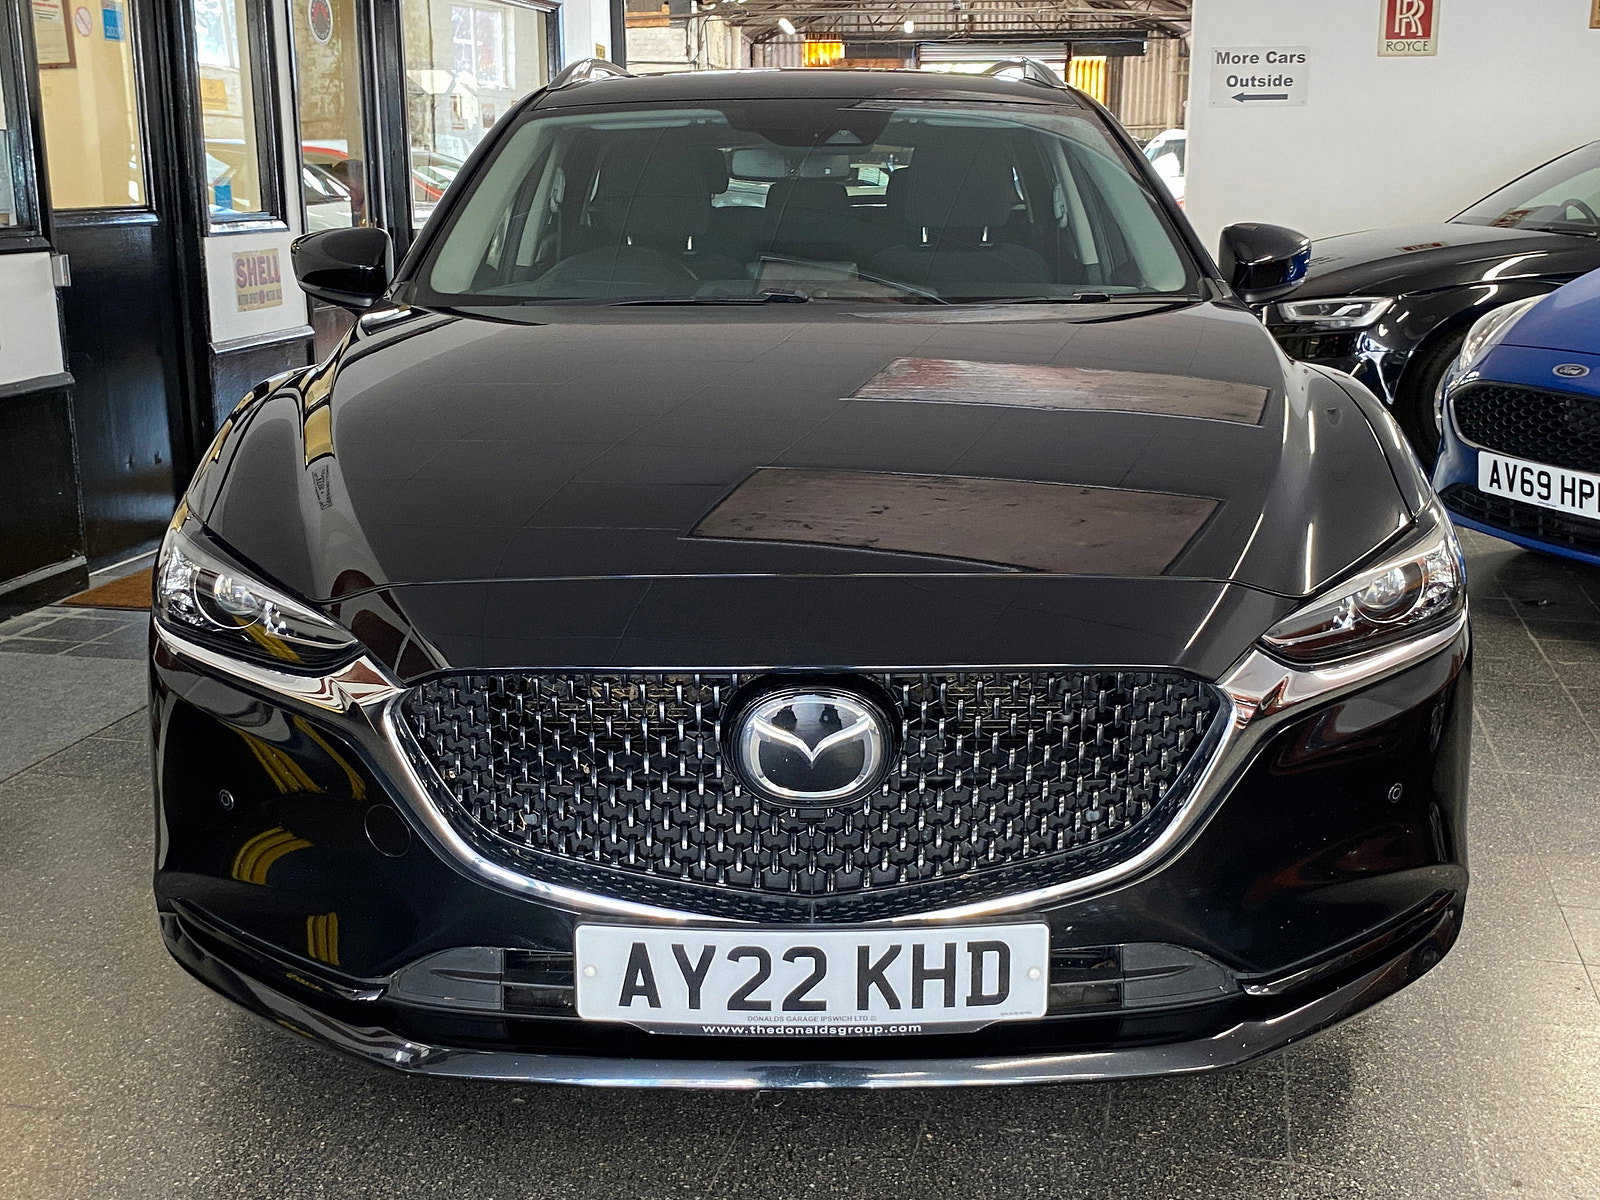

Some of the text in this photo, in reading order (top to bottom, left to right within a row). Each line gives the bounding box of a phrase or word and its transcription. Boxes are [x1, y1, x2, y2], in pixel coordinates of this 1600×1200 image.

[1385, 40, 1429, 52] ROYCE
[1215, 50, 1306, 65] More Cars
[1226, 74, 1294, 88] Outside
[235, 255, 281, 289] SHELL
[1489, 459, 1552, 501] AV69
[618, 940, 1012, 1012] AY22 KHD
[701, 1024, 922, 1036] www.thedonaldsgroup.com
